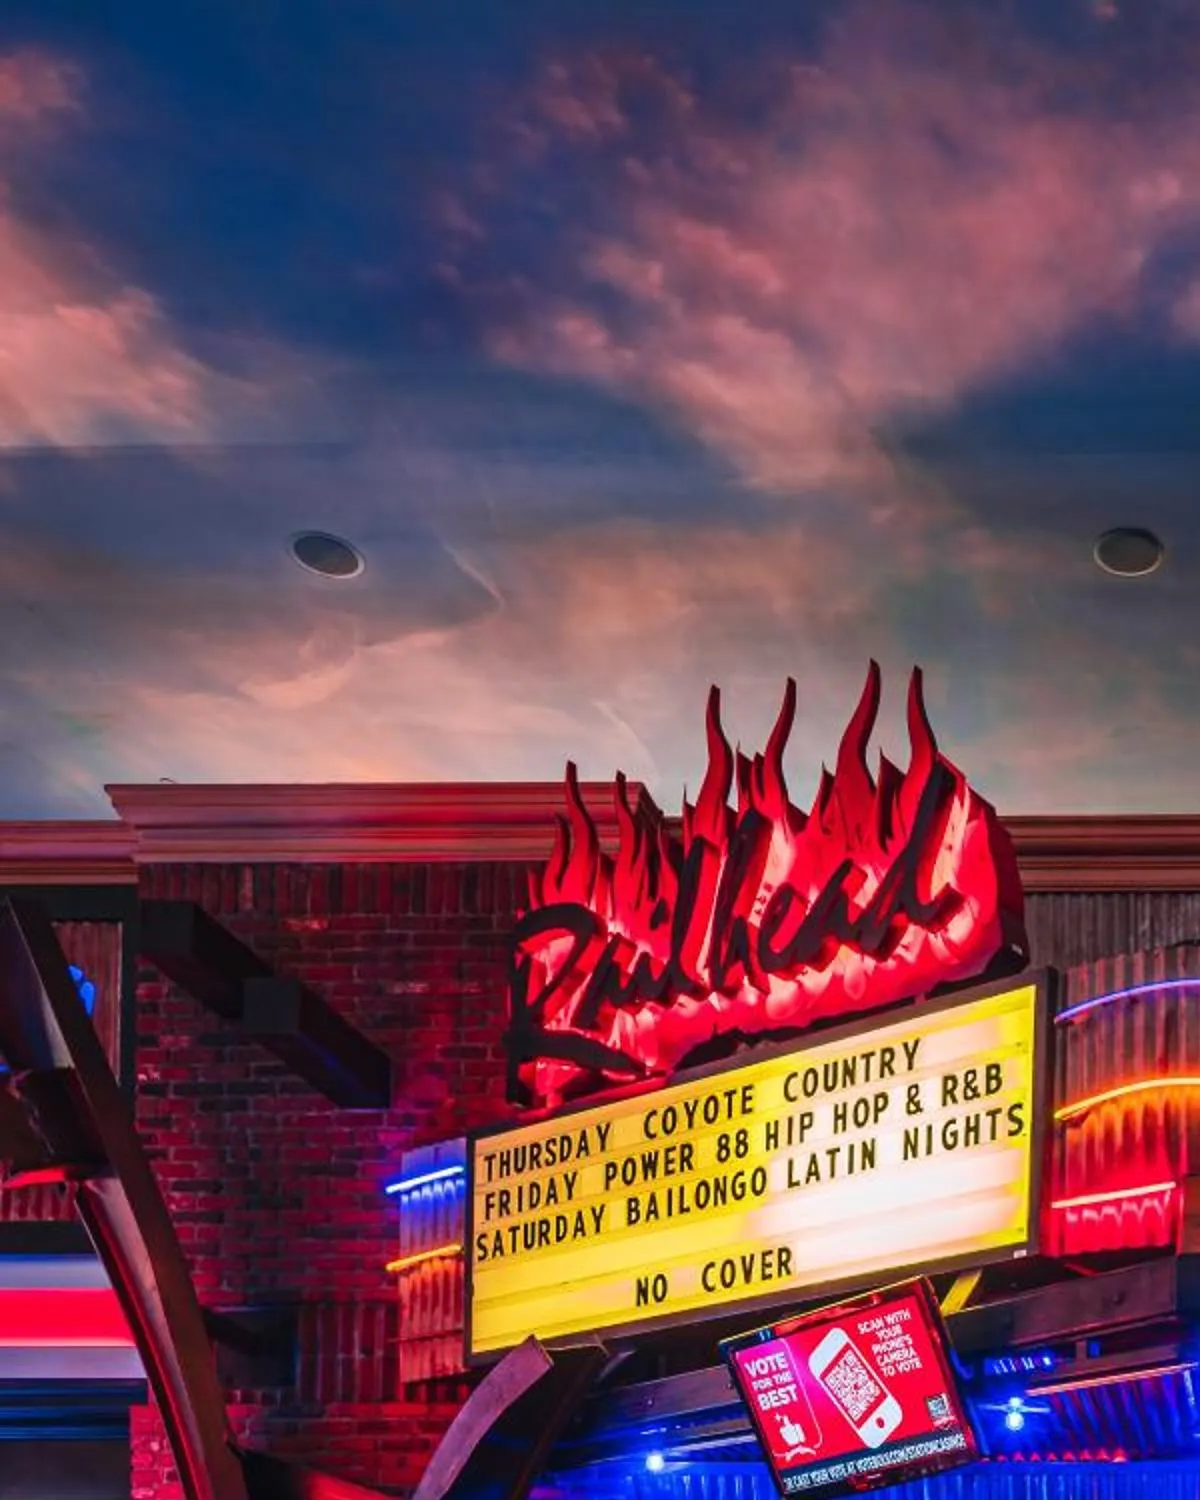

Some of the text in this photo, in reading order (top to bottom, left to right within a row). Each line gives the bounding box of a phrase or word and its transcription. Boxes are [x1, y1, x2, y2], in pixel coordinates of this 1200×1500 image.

[503, 754, 963, 1107] Railhead
[484, 1037, 921, 1182] THURSDAY COYOTE COUNTRY
[485, 1062, 1003, 1221] FRIDAY POWER 88 HIP HOP & R&B
[477, 1102, 1024, 1262] SATURDAY BAILONGO LATIN NIGHTS
[635, 1246, 793, 1307] NO COVER
[857, 1309, 912, 1335] SCAN WITH
[876, 1325, 902, 1342] YOUR
[744, 1352, 789, 1378] VOTE
[875, 1350, 916, 1369] CAMERA
[882, 1359, 922, 1377] TO VOTE
[752, 1372, 794, 1391] FOR THE
[757, 1384, 798, 1411] BEST
